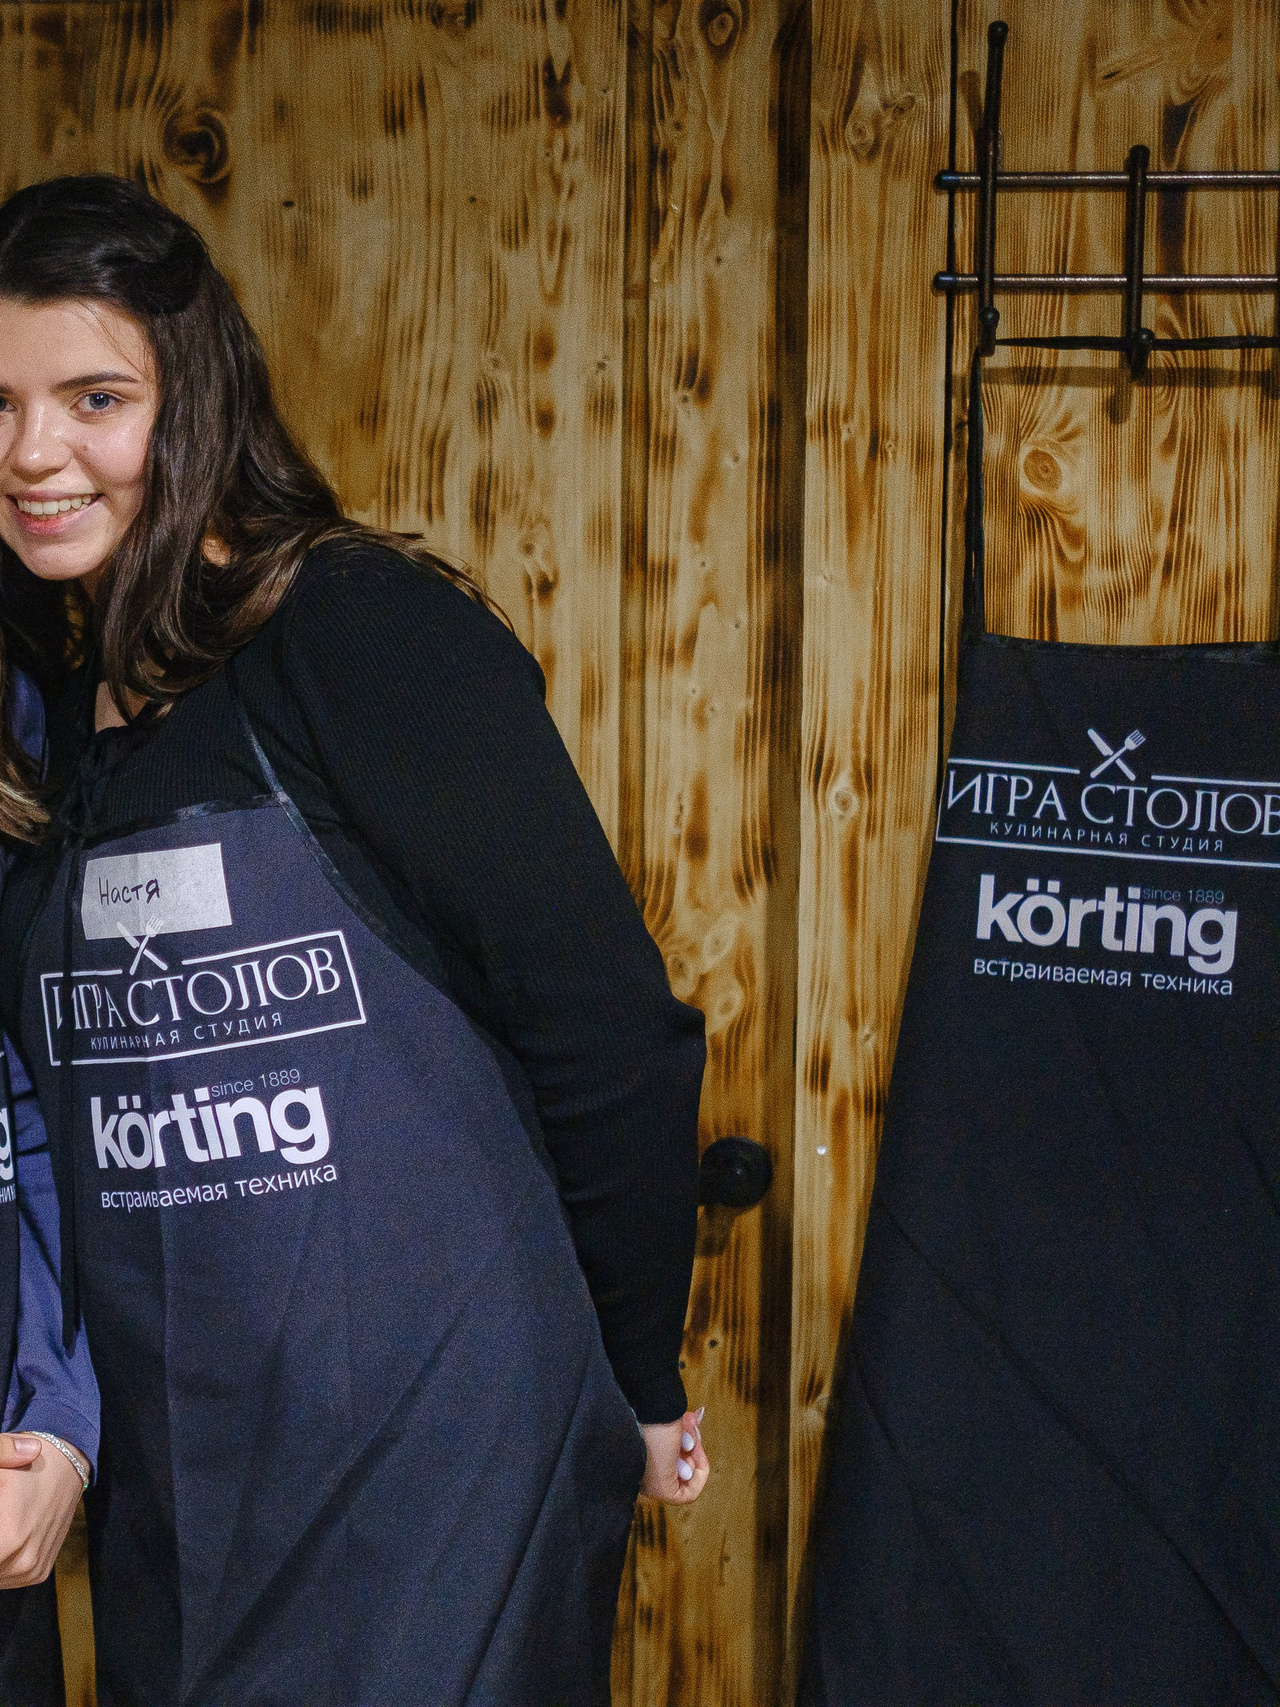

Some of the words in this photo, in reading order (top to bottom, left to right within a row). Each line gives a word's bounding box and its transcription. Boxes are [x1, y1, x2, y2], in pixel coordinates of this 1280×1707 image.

[947, 770, 1068, 821] ИГРА
[1080, 783, 1280, 837] СТОЛОВ
[989, 821, 1128, 846] КУЛИНАРНАЯ
[1141, 834, 1224, 853] СТУДИЯ
[98, 877, 160, 906] Настя
[1142, 887, 1181, 901] since
[1186, 889, 1225, 904] 1889
[976, 873, 1238, 975] körting
[127, 947, 341, 1026] СТОЛОВ
[973, 957, 1132, 988] встраиваемая
[1140, 972, 1233, 996] техника
[90, 1030, 180, 1051] КУЛИНАРНАЯ
[193, 1012, 283, 1041] СТУДИЯ
[211, 1076, 254, 1098] since
[259, 1068, 301, 1089] 1889
[90, 1086, 330, 1170] körting
[101, 1182, 228, 1213] встраиваемая
[234, 1164, 338, 1197] техника
